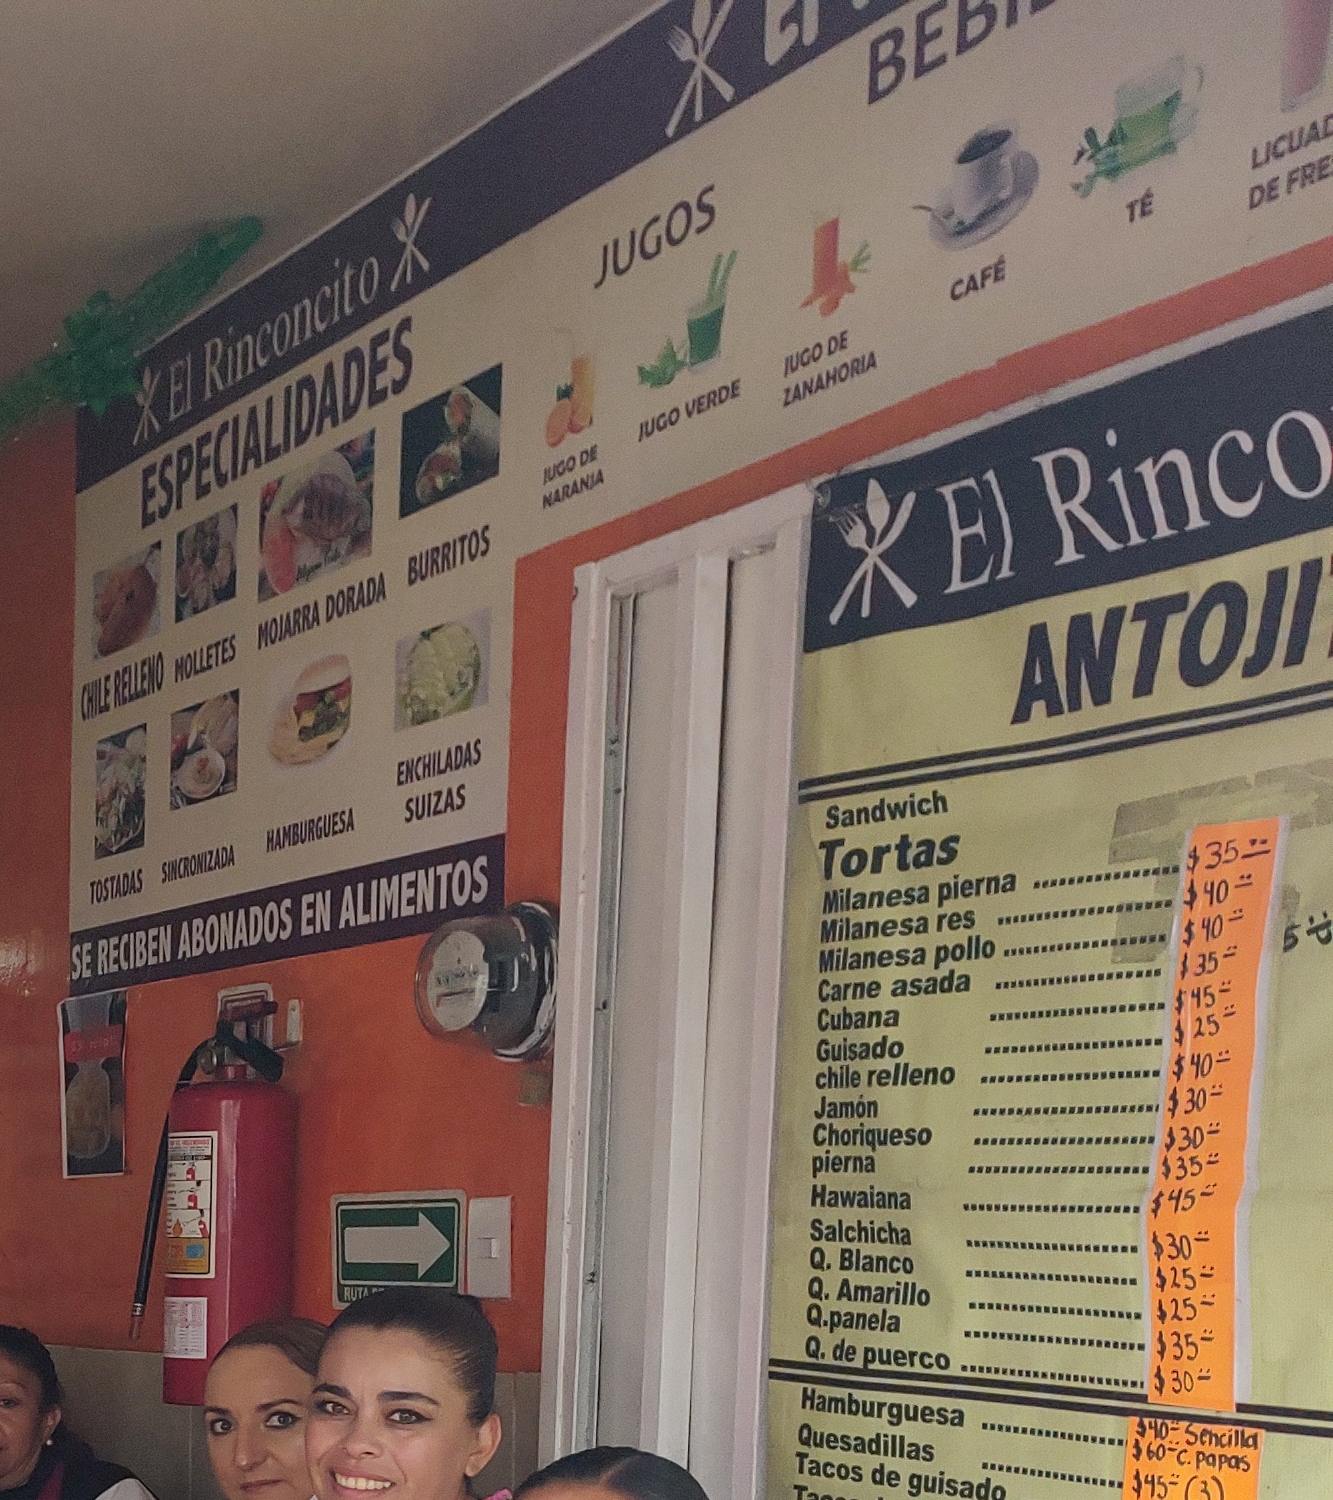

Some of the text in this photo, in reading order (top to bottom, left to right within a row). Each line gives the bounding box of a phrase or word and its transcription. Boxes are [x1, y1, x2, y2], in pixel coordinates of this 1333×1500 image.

[1126, 187, 1154, 223] TÉ
[1249, 176, 1279, 210] DE
[595, 185, 716, 288] JUGOS
[950, 255, 1007, 301] CAFÉ
[169, 254, 381, 422] El Rinconcito
[783, 331, 849, 377] JUGO DE
[783, 351, 878, 407] ZANAHORIA
[140, 315, 414, 529] ESPECIALIDADES
[638, 378, 741, 442] JUGO VERDE
[543, 445, 598, 485] JUGO DE
[542, 469, 604, 509] NARANJA
[936, 469, 1017, 595] El
[407, 525, 490, 587] BURRITOS
[258, 572, 387, 650] MOJARRA DORADA
[174, 635, 236, 683] MOLLETES
[81, 652, 164, 721] CHILE RELLENO
[396, 739, 481, 786] ENCHILADAS
[405, 784, 466, 823] SUIZAS
[826, 790, 949, 829] Sandwich
[266, 808, 355, 853] HAMBURGUESA
[162, 844, 235, 884] SINCRONIZADA
[819, 833, 961, 880] Tortas
[90, 869, 143, 905] TOSTADAS
[823, 872, 1017, 914] Milanesa pierna
[71, 855, 489, 981] SE RECIBEN ABONADOS EN ALIMENTOS
[820, 909, 976, 944] Milanesa res
[819, 935, 996, 973] Milanesa pollo
[818, 969, 971, 1003] Carne asada
[817, 1007, 900, 1032] Cubana
[816, 1035, 905, 1063] Guisado
[815, 1062, 956, 1090] chile relleno
[814, 1095, 878, 1120] Jamón
[813, 1122, 933, 1151] Choriqueso
[812, 1150, 876, 1178] pierna
[810, 1184, 912, 1211] Hawaiana
[810, 1218, 912, 1246] Salchicha
[809, 1246, 914, 1274] Q. Blanco
[808, 1276, 931, 1307] Q. Amarillo
[805, 1335, 951, 1370] Q. de puerco
[800, 1386, 965, 1428] Hamburguesa
[797, 1422, 935, 1463] Quesadillas
[1184, 1422, 1259, 1451] Sencilla
[795, 1451, 863, 1483] Tacos
[871, 1462, 901, 1487] de
[1196, 1452, 1252, 1472] papas
